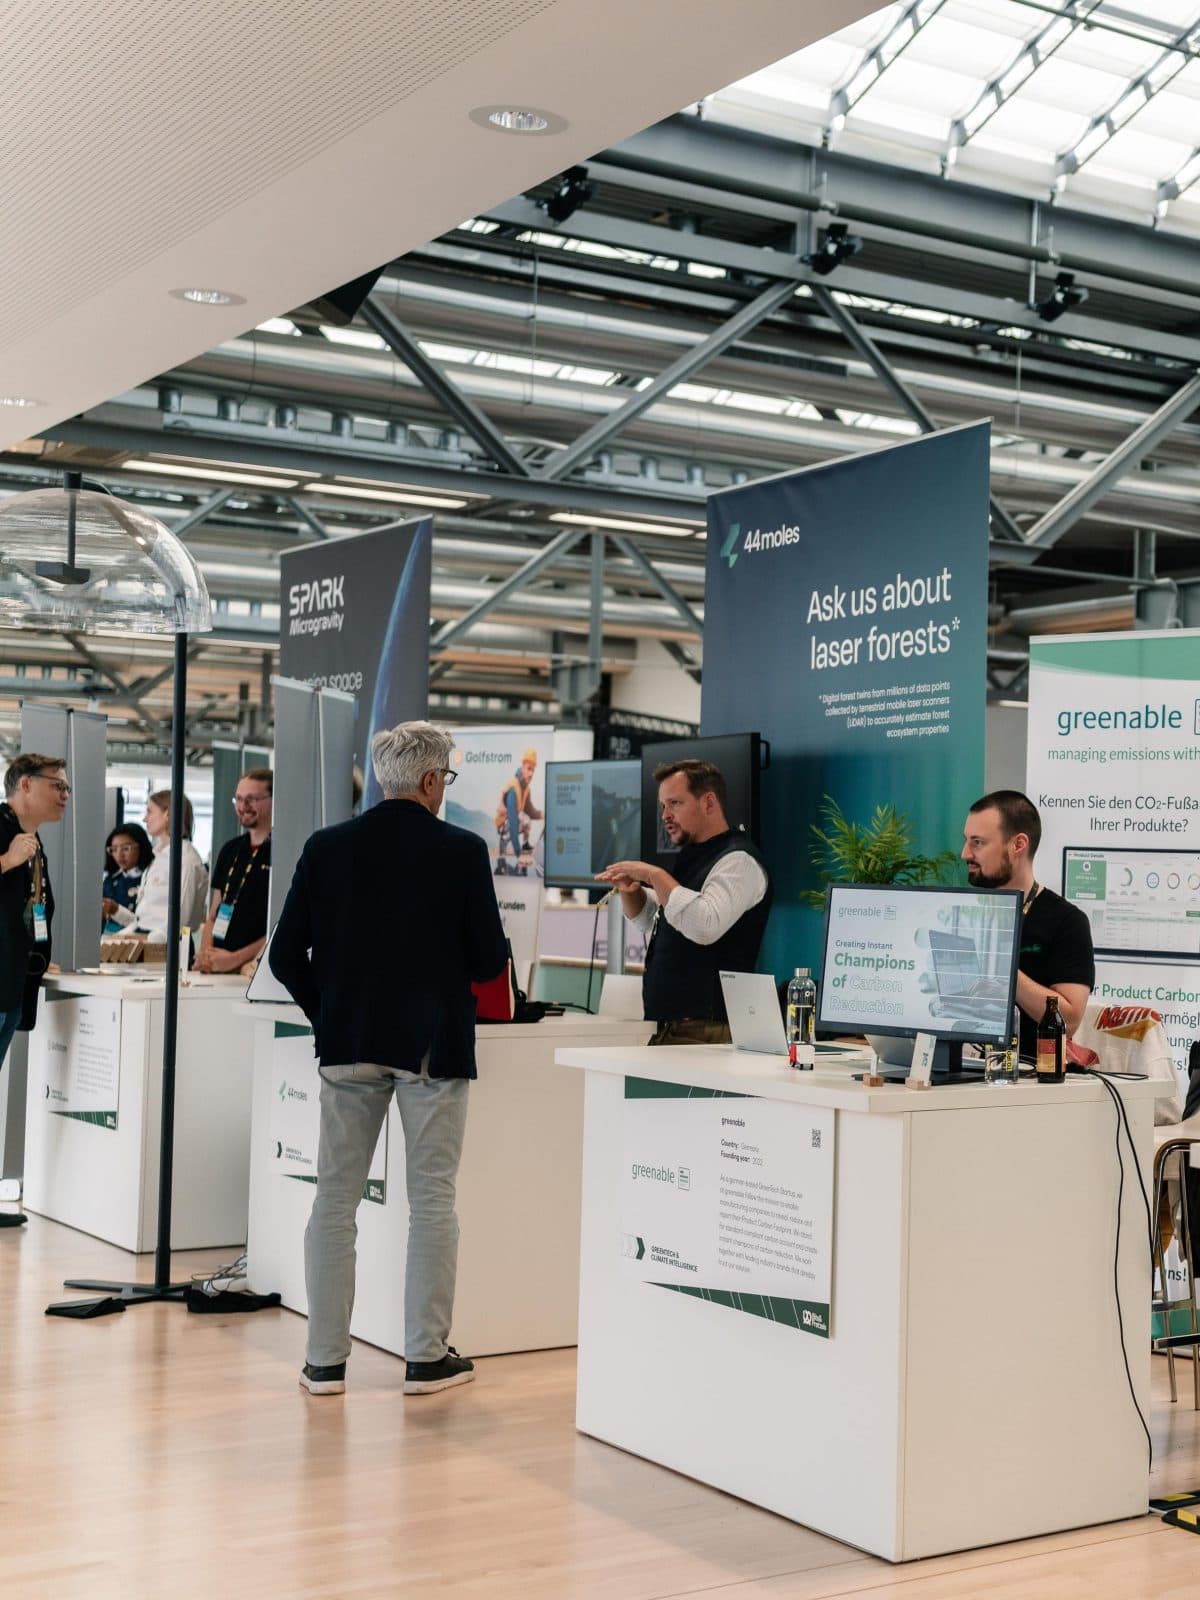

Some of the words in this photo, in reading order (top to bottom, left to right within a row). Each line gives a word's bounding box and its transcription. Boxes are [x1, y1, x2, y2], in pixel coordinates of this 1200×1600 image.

[744, 524, 800, 552] 44moles
[289, 575, 344, 616] SPARK
[807, 585, 846, 624] Ask
[851, 586, 876, 617] us
[883, 567, 952, 612] about
[289, 611, 345, 636] Microgravity
[810, 635, 862, 670] laser
[840, 691, 856, 702] forest
[872, 688, 886, 699] from
[886, 685, 908, 697] millions
[909, 683, 916, 694] of
[916, 682, 930, 693] data
[931, 680, 950, 693] points
[825, 704, 851, 717] collected
[886, 699, 906, 710] mobile
[907, 698, 921, 708] laser
[922, 695, 950, 707] scanners
[867, 716, 873, 726] to
[874, 712, 905, 725] accurately
[905, 710, 931, 721] estimate
[932, 709, 950, 720] forest
[1057, 704, 1183, 736] greenable
[886, 726, 918, 739] ecosystem
[919, 724, 949, 737] properties
[465, 751, 512, 764] Golfstrom
[1048, 747, 1107, 763] managing
[1109, 748, 1170, 761] emissions
[1173, 747, 1200, 760] with
[1039, 794, 1084, 808] Kennen
[1088, 795, 1106, 809] Sie
[1109, 795, 1132, 809] den
[1090, 817, 1120, 831] Ihrer
[1124, 818, 1189, 833] Produkte?
[838, 905, 881, 920] greenable
[835, 939, 866, 950] Creating
[868, 940, 893, 950] Instant
[834, 952, 915, 972] Champions
[832, 974, 847, 989] of
[851, 975, 902, 993] Carbon
[1102, 983, 1153, 1000] Product
[830, 995, 904, 1016] Reduction
[721, 1117, 746, 1128] greenable
[632, 1163, 675, 1184] greenable
[651, 1245, 676, 1258] GREENTECH
[651, 1254, 669, 1265] CLIMATE
[669, 1258, 698, 1273] INTELLIGENCE
